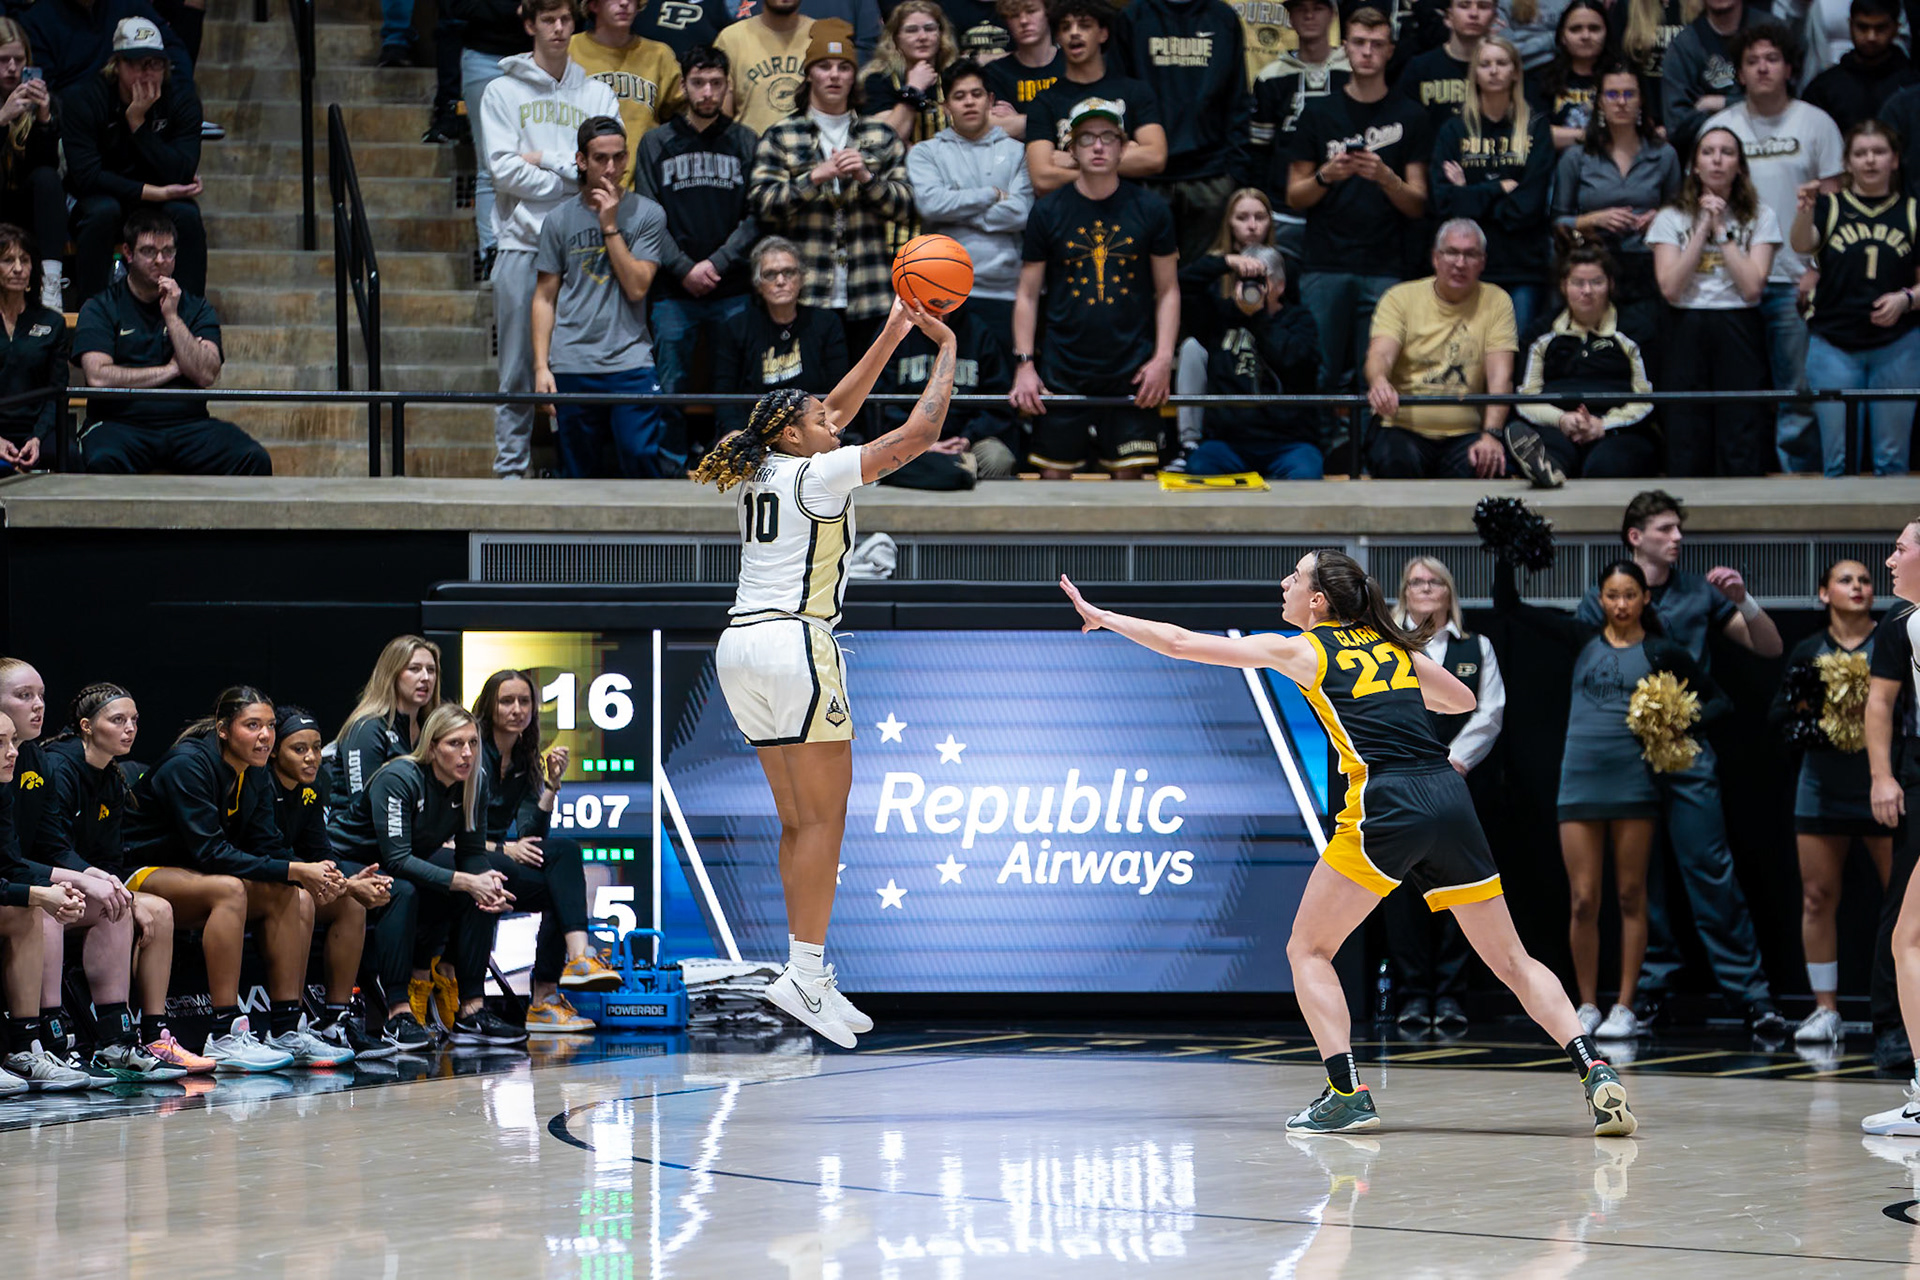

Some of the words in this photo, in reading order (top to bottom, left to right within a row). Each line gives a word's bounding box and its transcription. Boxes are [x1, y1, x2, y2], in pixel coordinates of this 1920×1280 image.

[657, 1, 703, 30] P
[1233, 2, 1292, 28] PURD
[746, 56, 806, 86] PURD
[593, 71, 659, 113] RDUE
[1420, 79, 1470, 107] PUR
[519, 100, 591, 130] PURDU
[662, 150, 745, 187] PURDUE
[1828, 221, 1912, 258] PURDUE
[1864, 244, 1880, 280] 1
[898, 354, 979, 388] PUUE
[748, 467, 778, 484] ERRY
[743, 492, 780, 544] 10
[1332, 624, 1384, 648] CLARK
[1335, 641, 1420, 700] 22
[541, 672, 635, 731] 16
[348, 748, 364, 795] IOWA
[387, 795, 403, 838] IOWA
[874, 768, 1187, 849] Republic
[997, 839, 1195, 895] Airways
[607, 1004, 665, 1016] POWERADE
